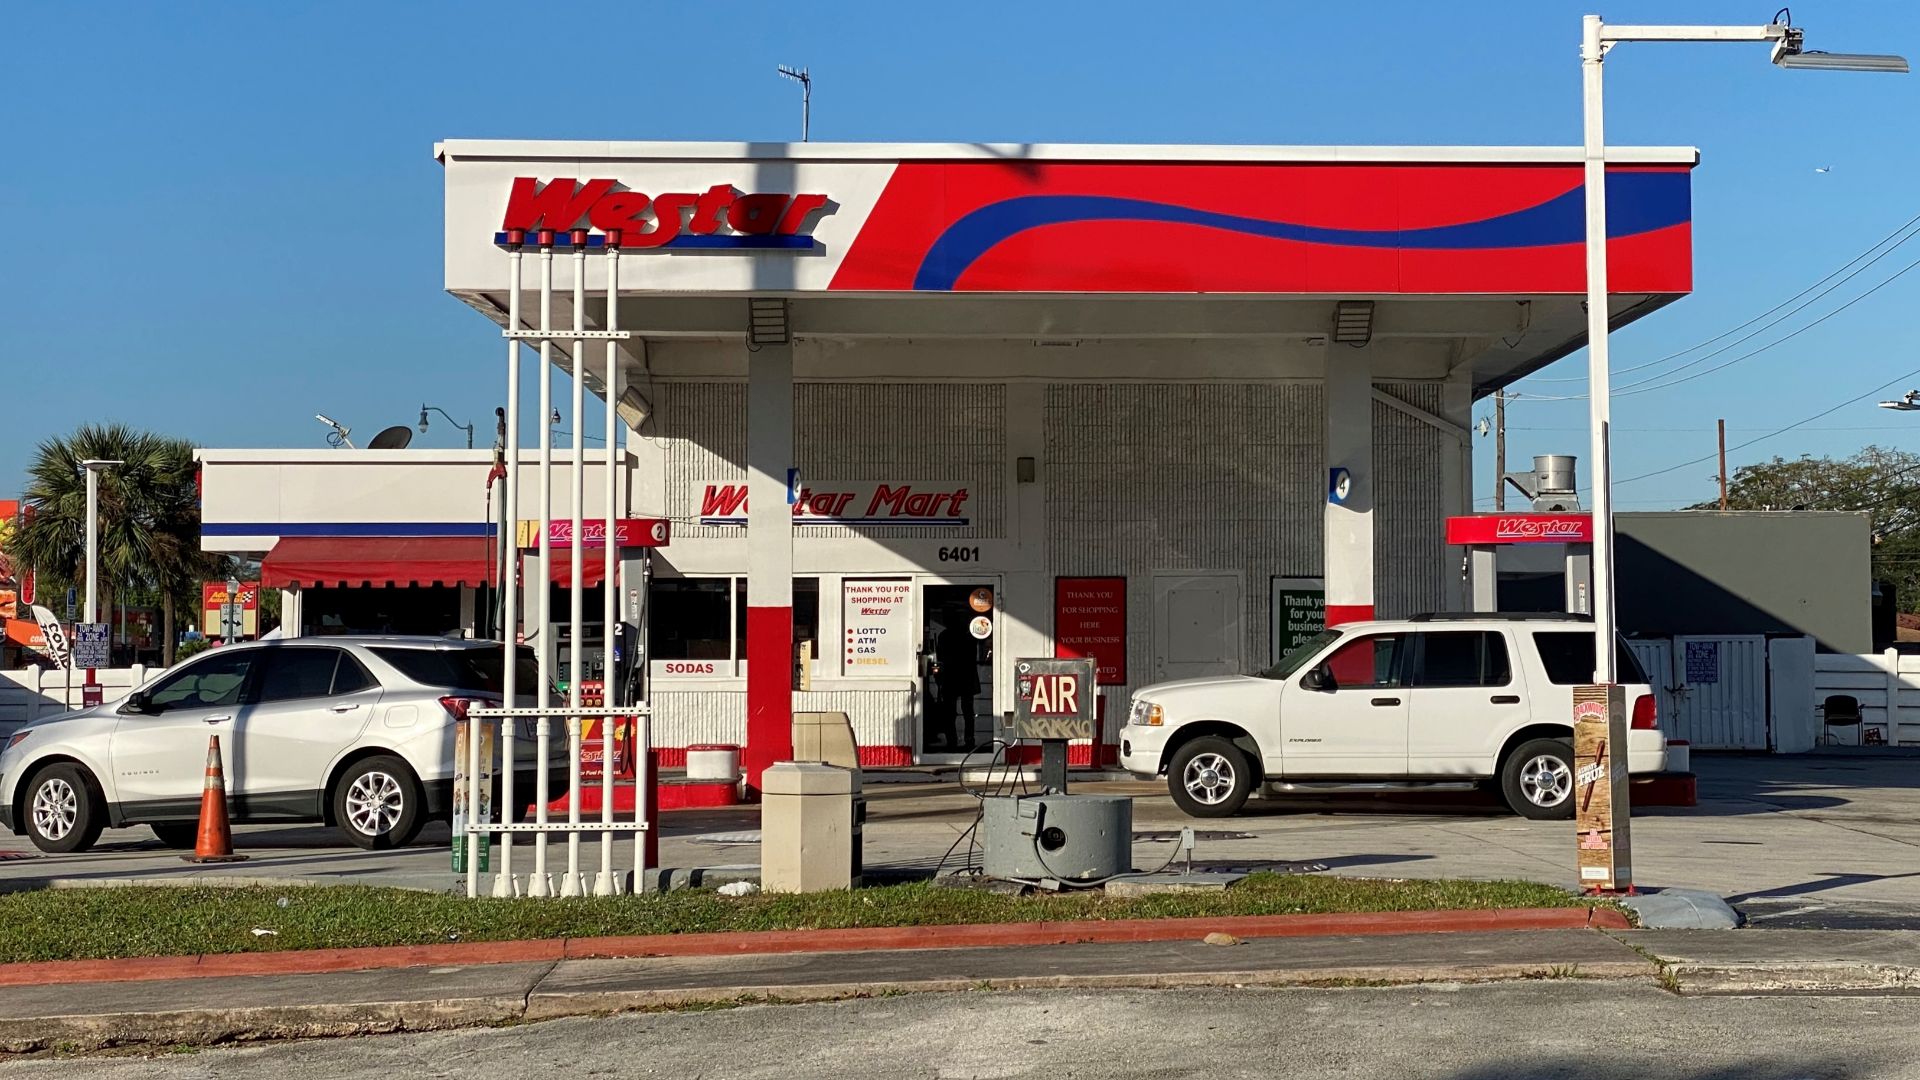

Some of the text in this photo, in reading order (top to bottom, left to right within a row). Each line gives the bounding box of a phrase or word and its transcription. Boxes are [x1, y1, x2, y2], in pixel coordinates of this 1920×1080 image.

[502, 176, 828, 248] Westar
[1339, 477, 1346, 493] 4
[700, 484, 968, 516] Wtar Mart
[656, 526, 663, 538] 2
[1497, 519, 1582, 537] Westar
[938, 546, 979, 562] 6401
[1066, 591, 1113, 599] THANK YOU
[1284, 595, 1325, 609] Thank yo
[861, 607, 891, 615] Westar
[1062, 606, 1118, 614] FOR SHOPPING
[1290, 608, 1304, 619] for
[614, 623, 623, 635] 2
[1079, 621, 1100, 629] HERE
[85, 633, 100, 641] ZONE
[1061, 636, 1120, 644] YOUR BUSINESS
[665, 663, 714, 674] SODAS
[1030, 676, 1078, 713] AIR
[1578, 766, 1605, 787] TRUE
